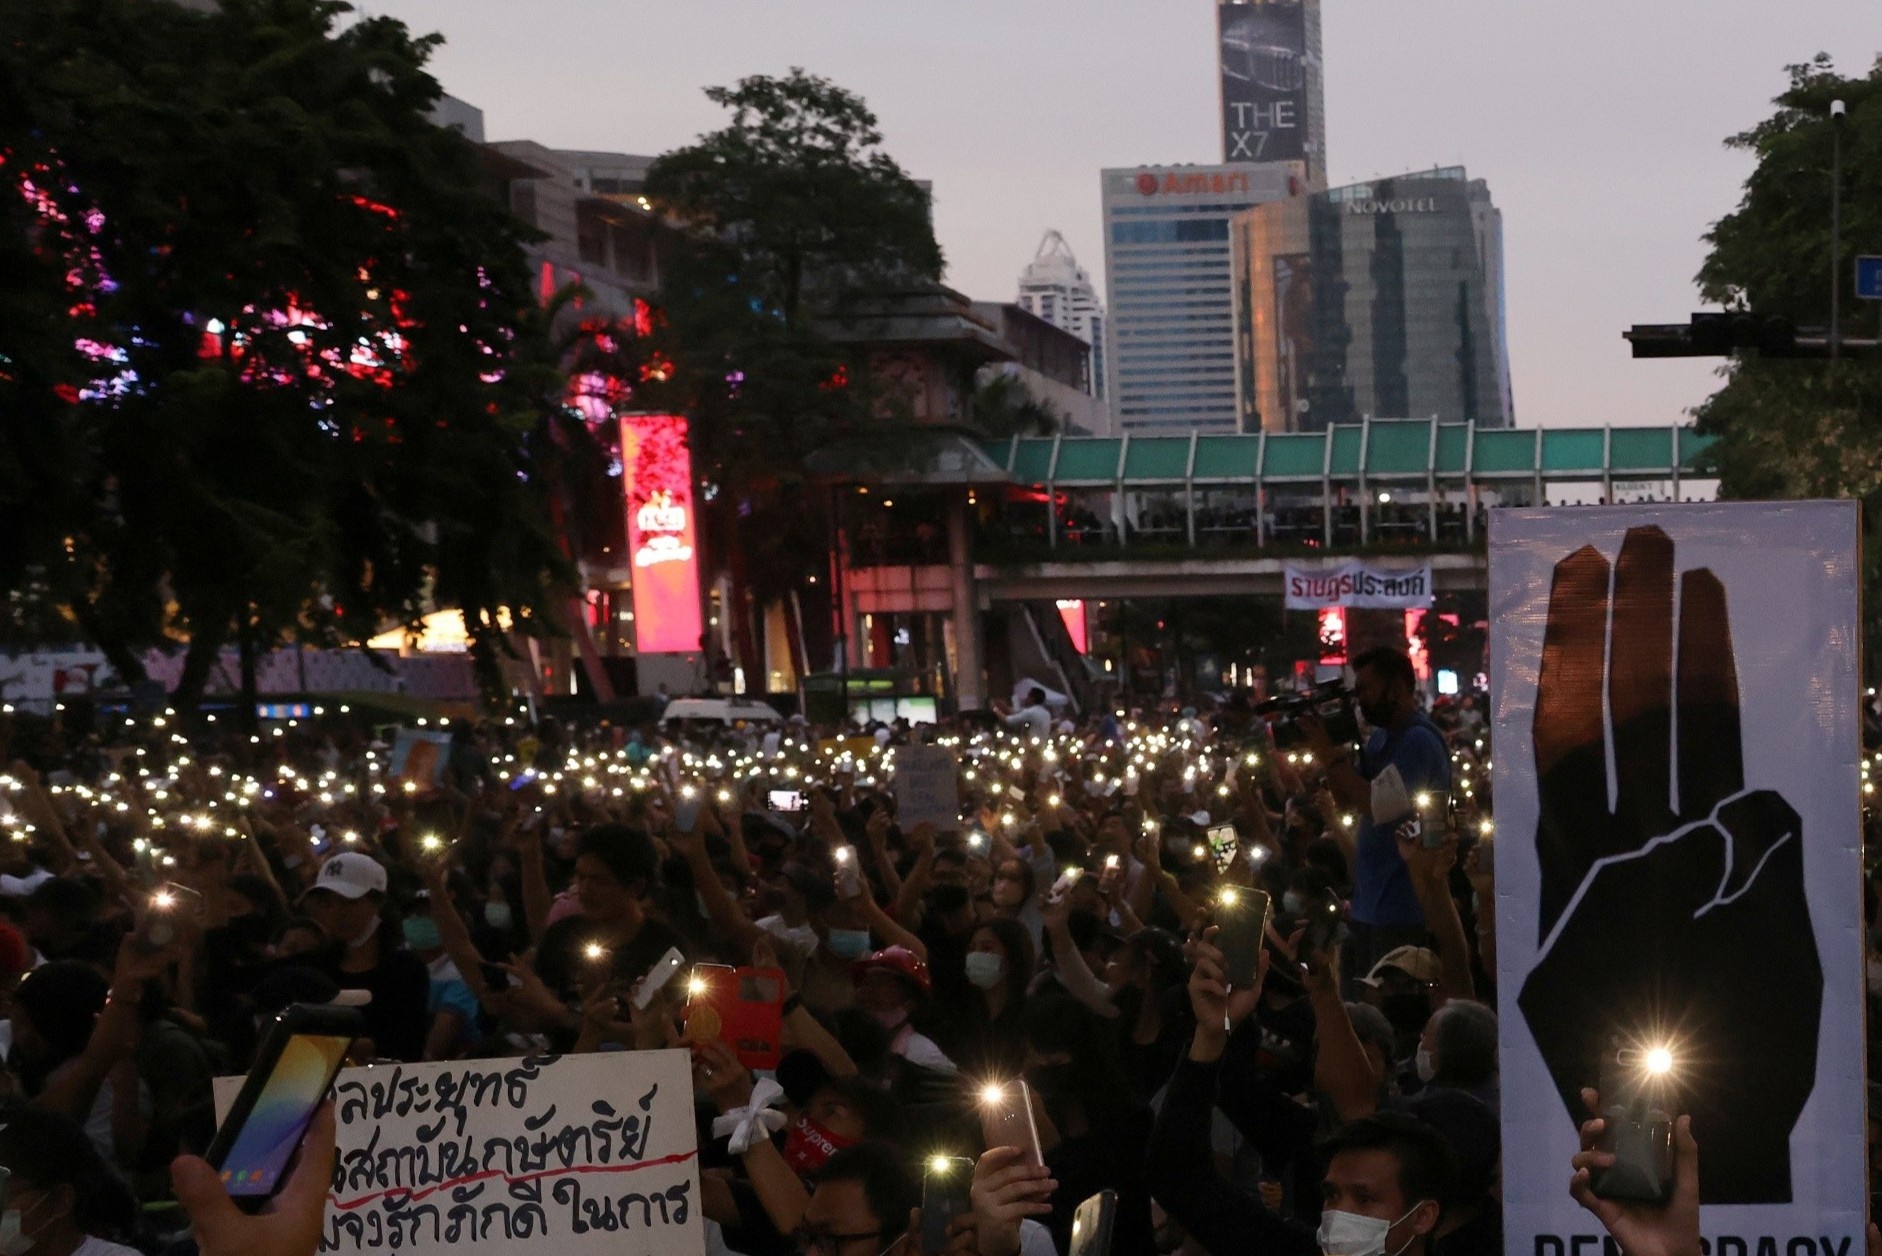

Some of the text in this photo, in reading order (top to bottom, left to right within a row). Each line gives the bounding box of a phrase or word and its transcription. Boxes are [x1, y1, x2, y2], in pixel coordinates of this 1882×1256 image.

[1230, 100, 1297, 129] THE
[1230, 131, 1269, 158] X7
[1349, 197, 1438, 215] NOVOTEL
